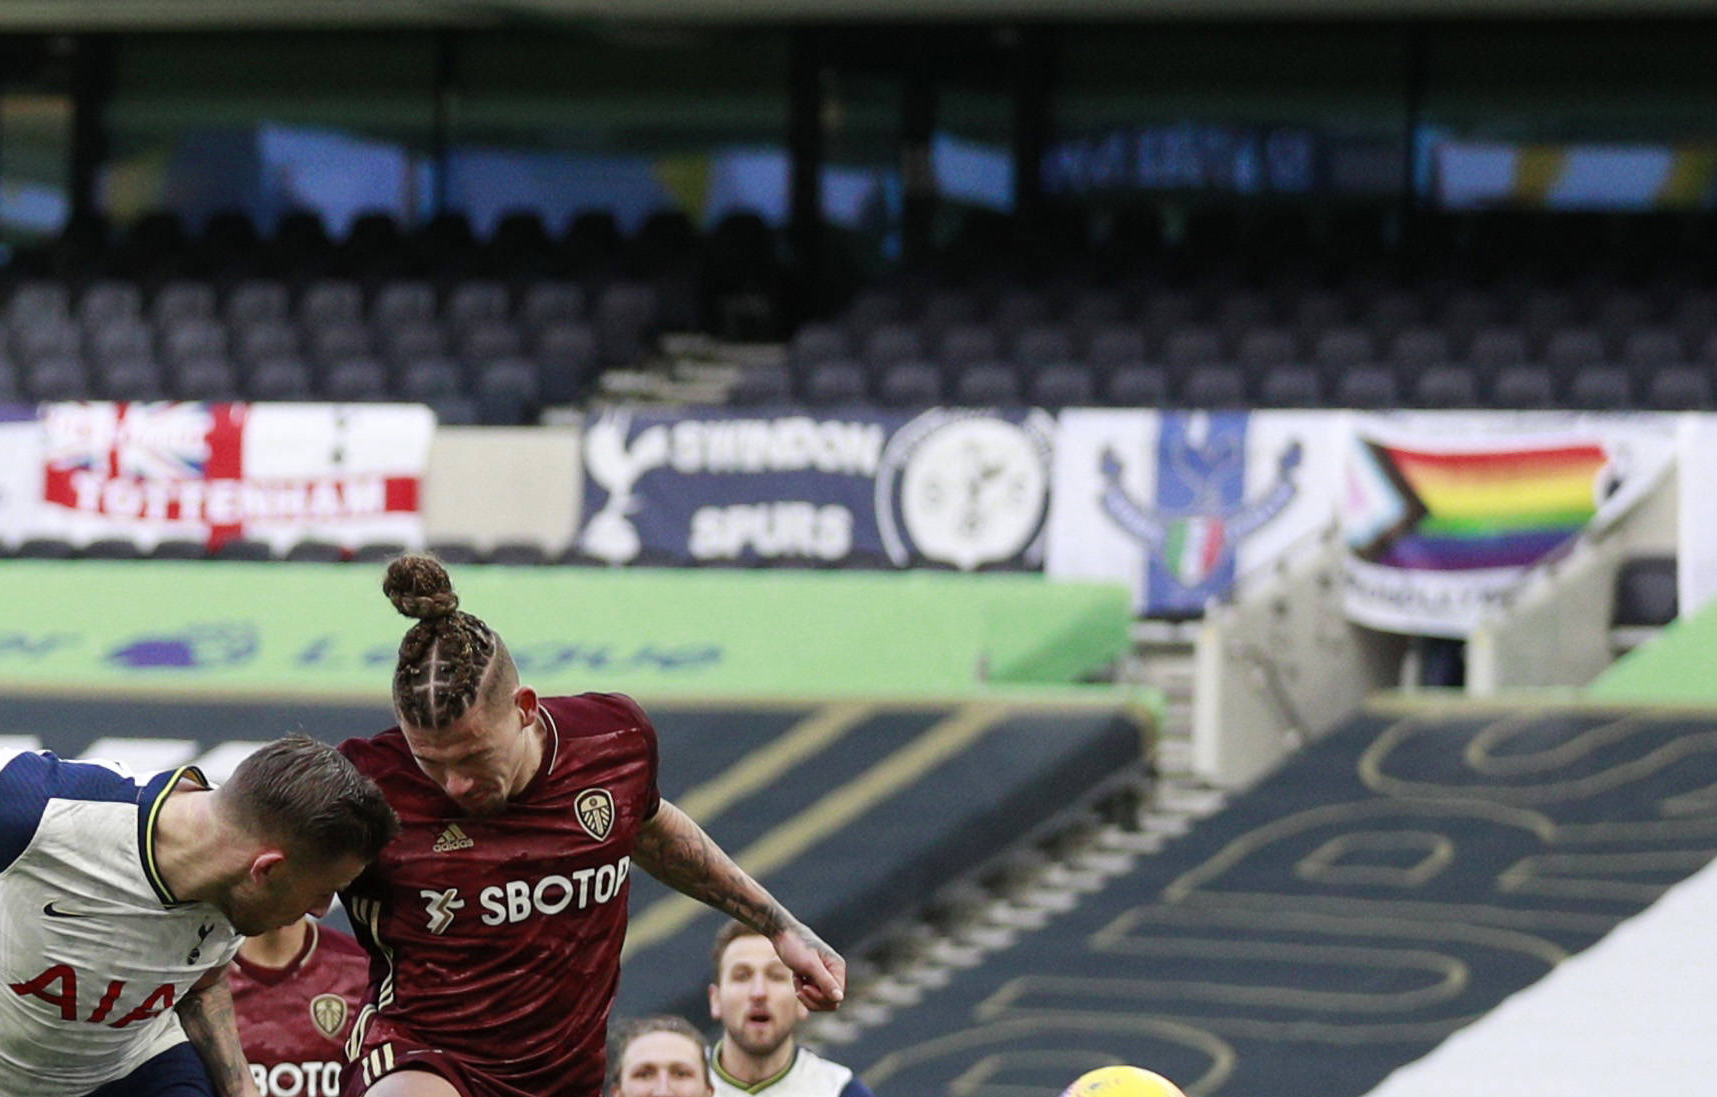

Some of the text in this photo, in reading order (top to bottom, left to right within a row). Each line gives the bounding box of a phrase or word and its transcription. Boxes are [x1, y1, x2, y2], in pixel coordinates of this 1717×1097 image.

[672, 418, 882, 477] SWINDON
[69, 472, 386, 524] TOTTENHAM
[688, 502, 854, 561] SPURS
[433, 838, 475, 853] adidas
[479, 855, 631, 926] SBOTOP
[8, 963, 176, 1029] AIA
